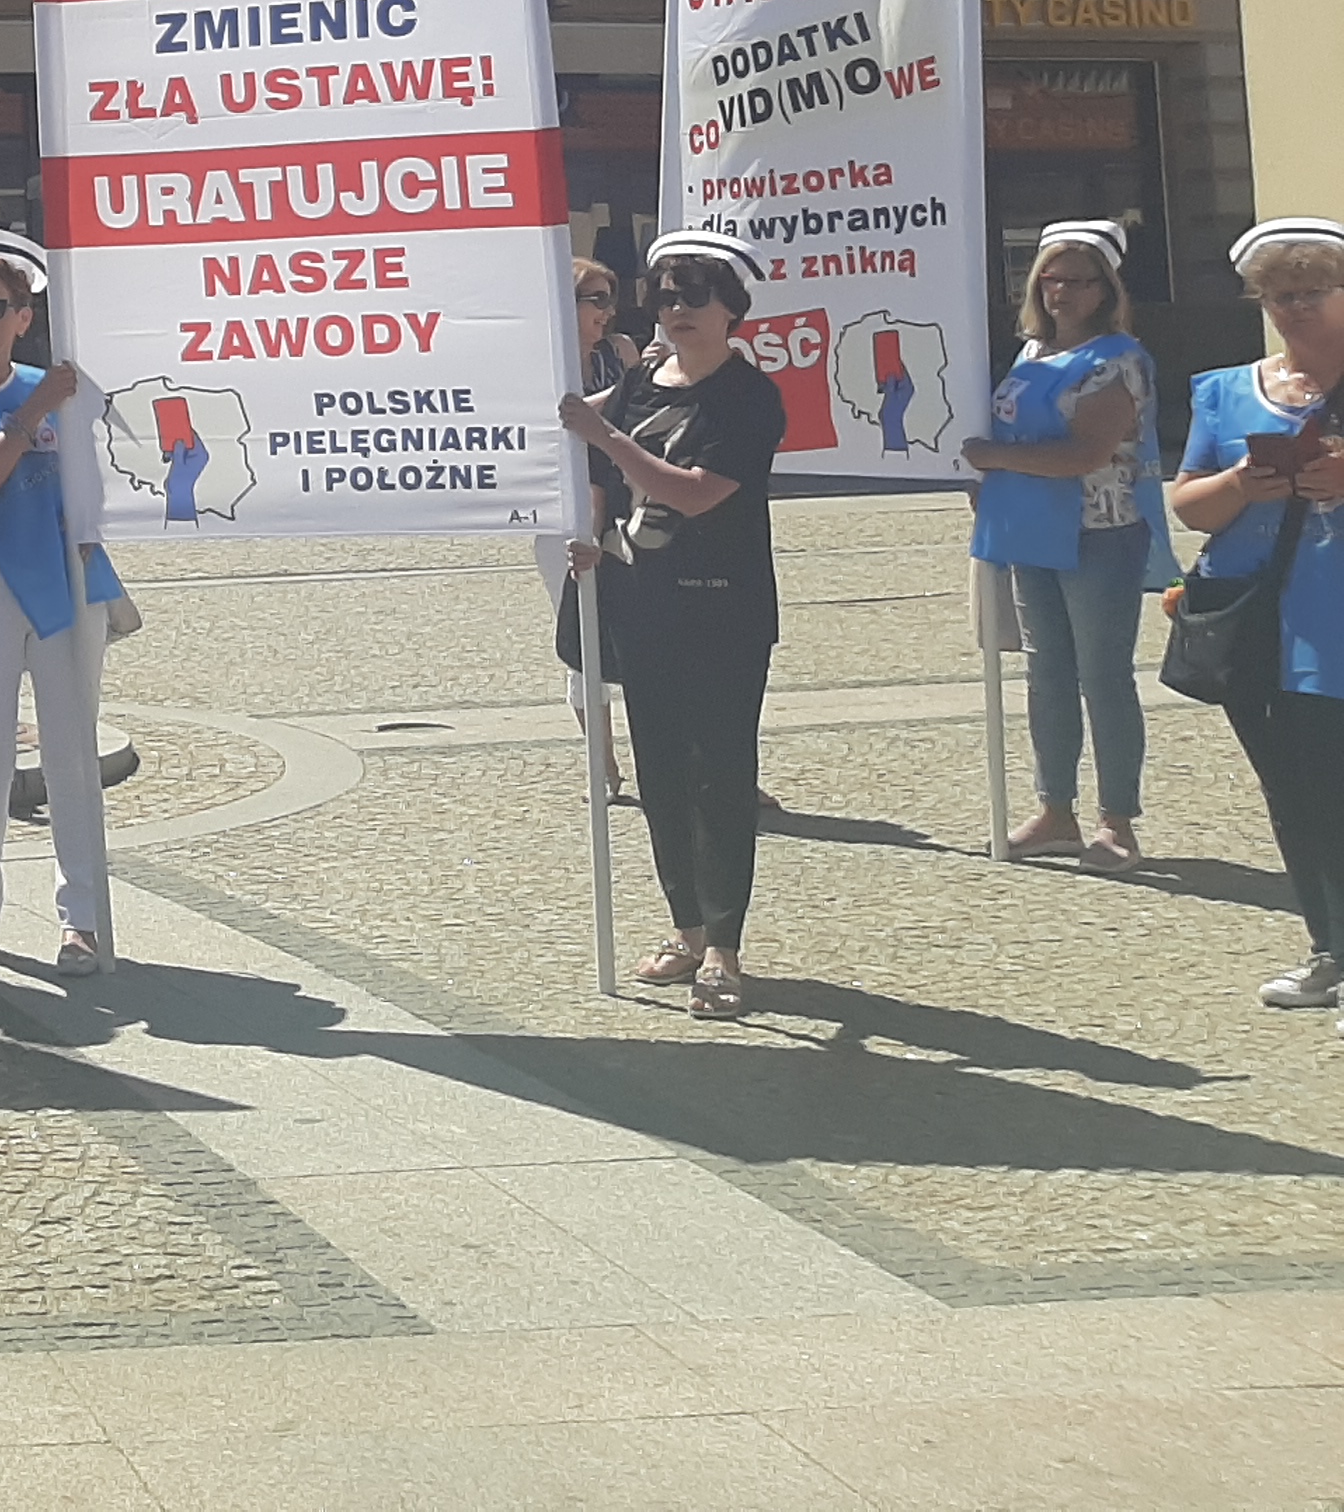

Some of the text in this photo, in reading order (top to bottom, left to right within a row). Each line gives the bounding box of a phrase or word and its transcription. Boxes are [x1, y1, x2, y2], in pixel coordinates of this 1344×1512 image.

[712, 10, 872, 87] DODATKI
[88, 55, 495, 124] ZŁĄ USTAWĘ!
[688, 55, 941, 155] COVID(M)OWE
[94, 154, 514, 229] URATUJCIE
[702, 159, 893, 206] prowizorka
[701, 196, 947, 244] dla wybranych
[202, 246, 410, 298] NASZE
[801, 245, 916, 278] znikną
[180, 312, 441, 362] ZAWODY
[726, 316, 821, 374] OŚĆ
[314, 389, 475, 416] POLSKIE
[269, 425, 526, 459] PIELĘGNIARKI
[301, 459, 498, 493] I POŁOŻNE
